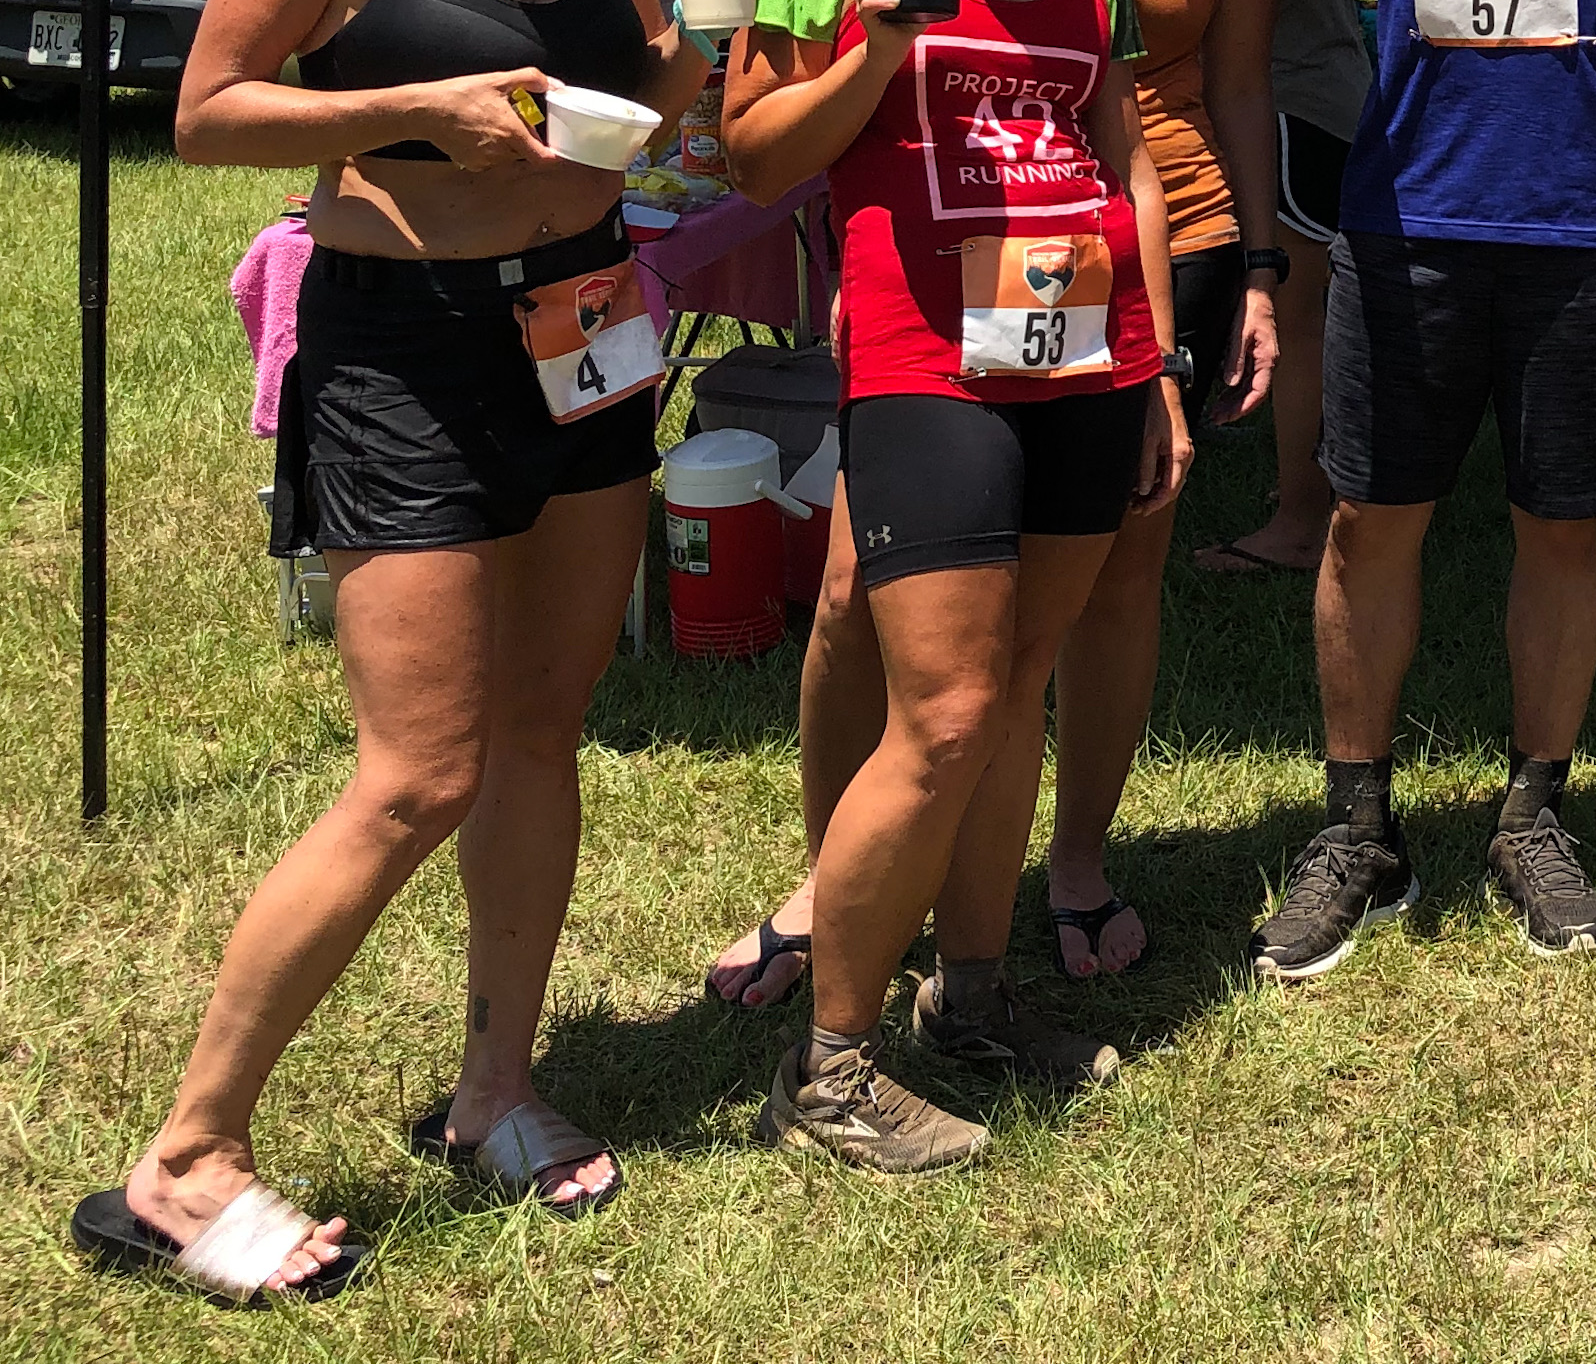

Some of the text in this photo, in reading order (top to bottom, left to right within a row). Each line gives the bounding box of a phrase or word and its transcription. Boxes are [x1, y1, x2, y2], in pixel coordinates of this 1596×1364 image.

[34, 24, 64, 50] BXC
[944, 72, 1074, 101] PROJECT
[965, 95, 1074, 162] 42
[959, 163, 1084, 185] RUNNING
[1022, 311, 1066, 366] 53
[577, 350, 607, 395] 4
